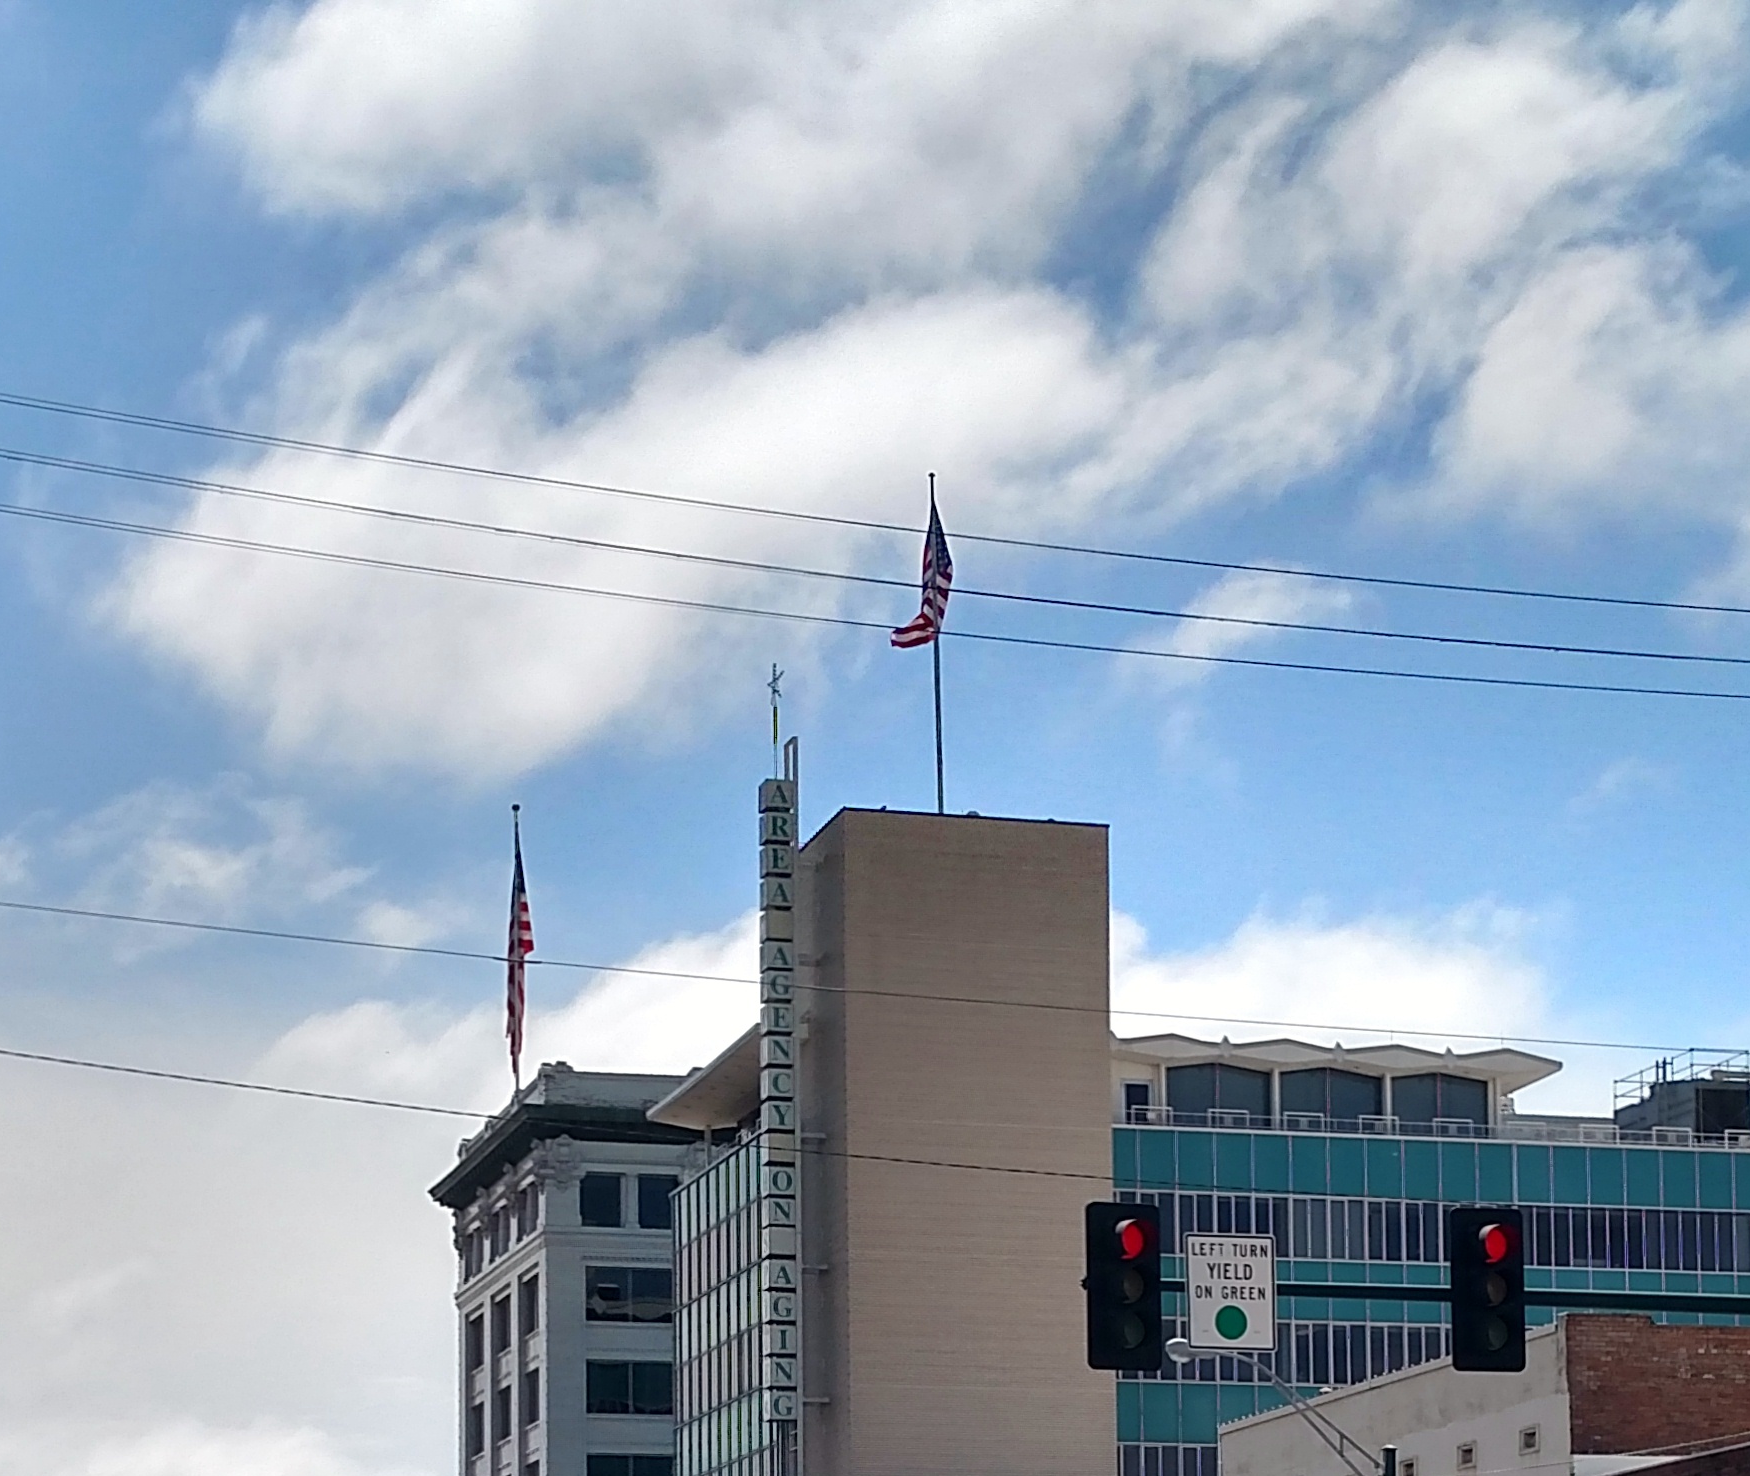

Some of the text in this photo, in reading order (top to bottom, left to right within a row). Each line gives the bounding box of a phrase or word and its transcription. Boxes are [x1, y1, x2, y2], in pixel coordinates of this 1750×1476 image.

[767, 783, 795, 1418] AREA AGENCY ON AGING
[1191, 1242, 1269, 1259] LEFT TURN
[1206, 1263, 1253, 1281] YIELD
[1195, 1285, 1266, 1301] ON GREEN
